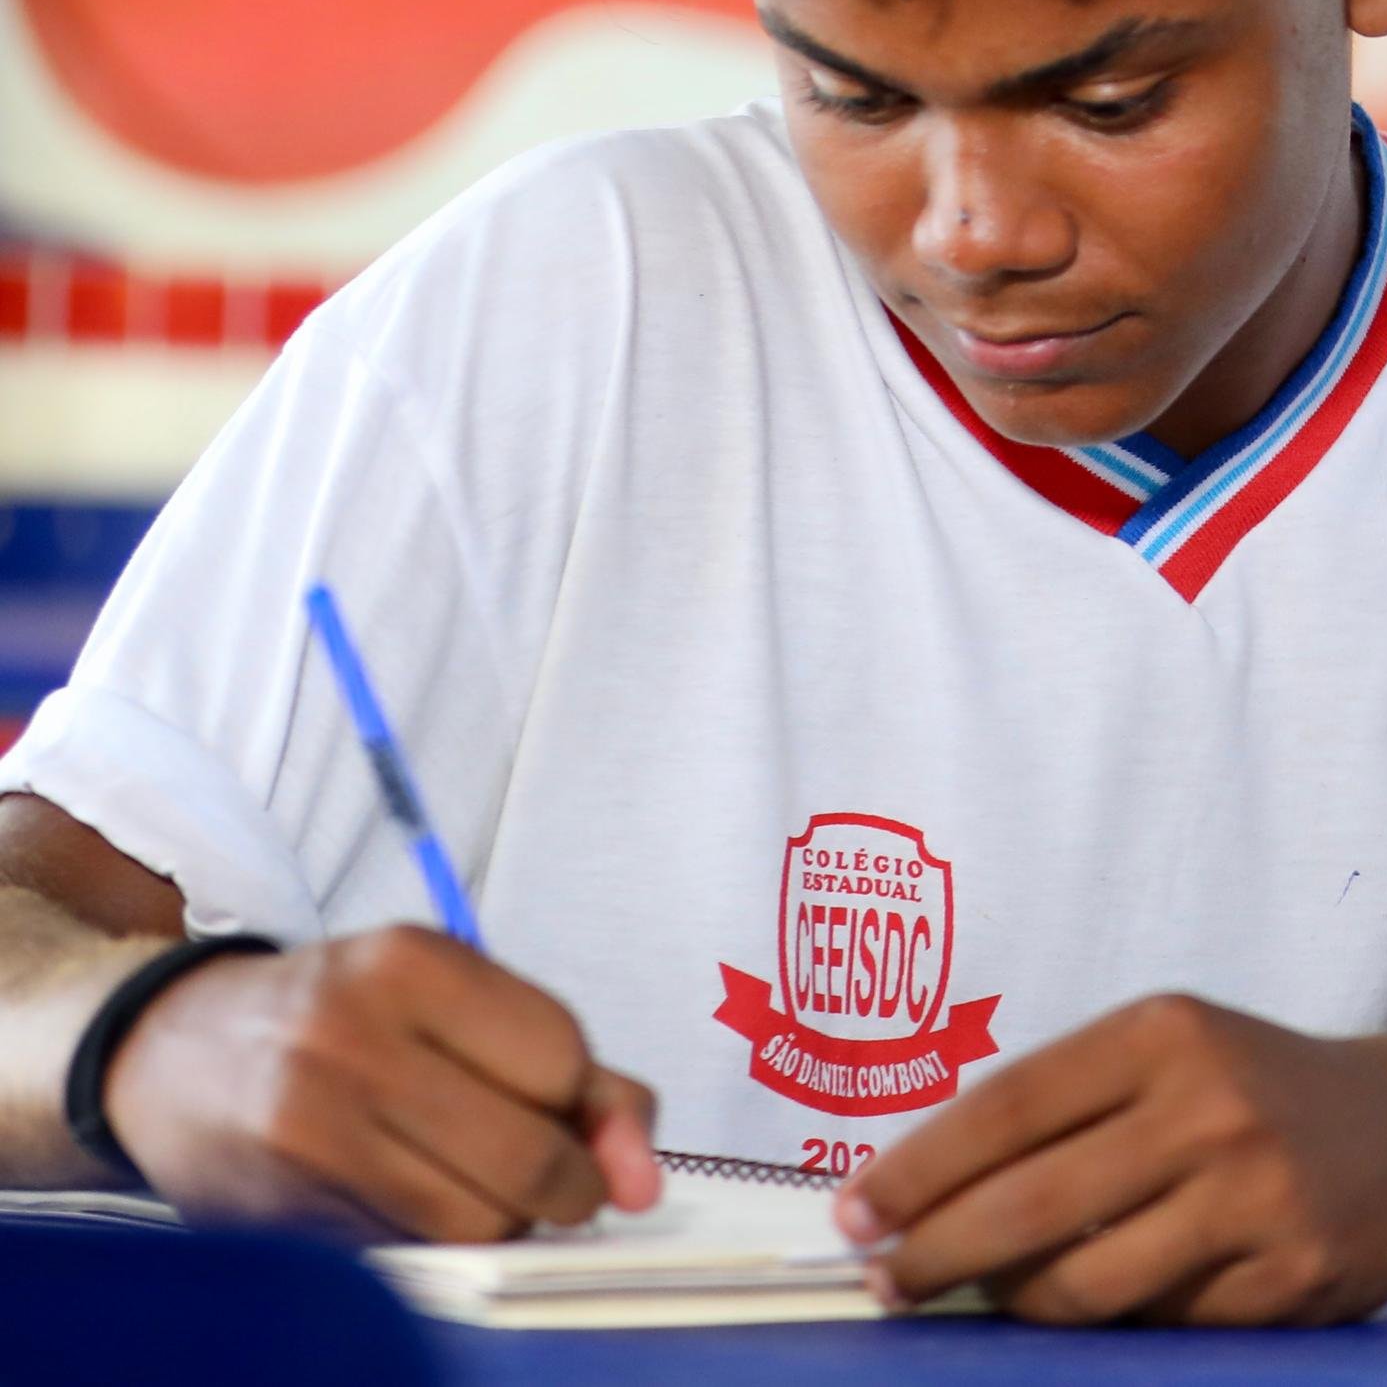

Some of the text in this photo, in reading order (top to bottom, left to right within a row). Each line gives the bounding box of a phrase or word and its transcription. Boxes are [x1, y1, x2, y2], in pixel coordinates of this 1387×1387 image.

[801, 847, 924, 879] COLÉGIO
[801, 872, 923, 902] ESTADUAL
[795, 900, 931, 1024] CEEISDC
[759, 1032, 950, 1099] SÃO DANIEL COMBONI
[798, 1137, 877, 1179] 202
